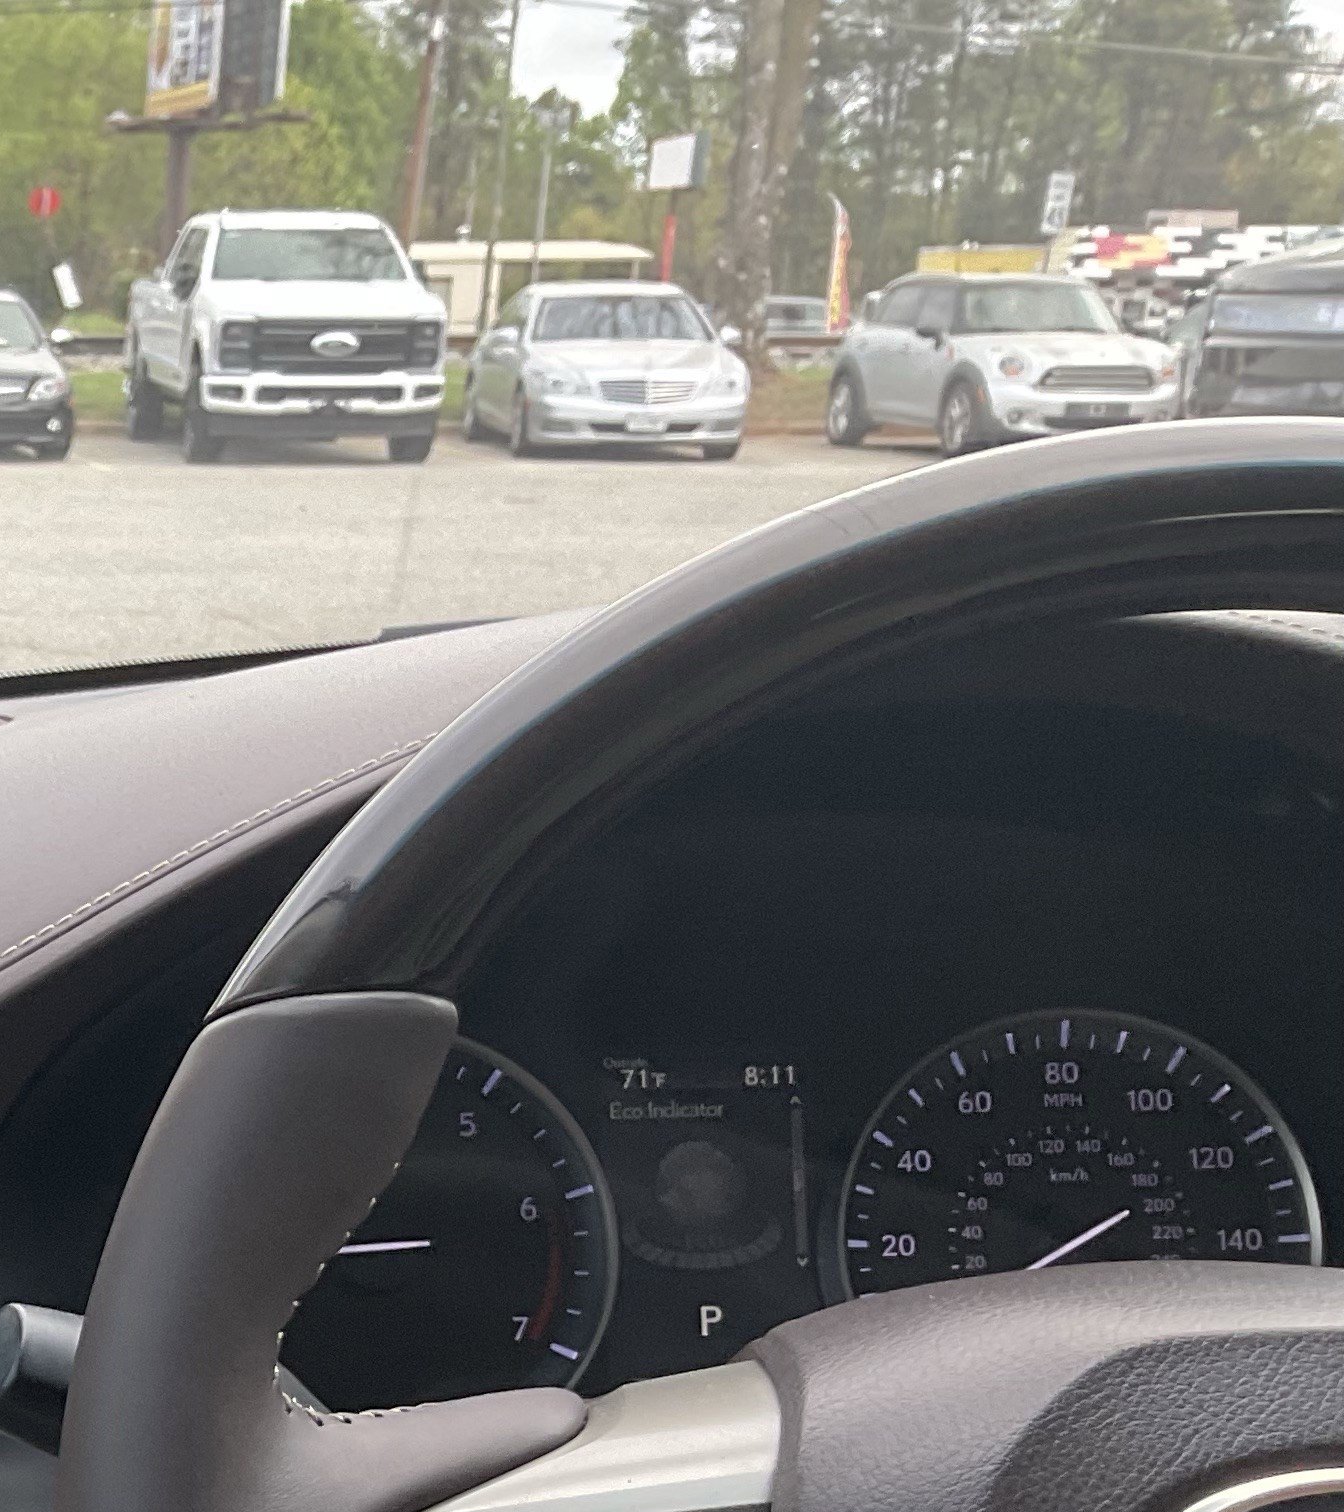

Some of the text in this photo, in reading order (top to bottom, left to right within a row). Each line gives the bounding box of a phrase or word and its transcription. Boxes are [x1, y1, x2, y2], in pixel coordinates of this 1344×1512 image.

[744, 1065, 795, 1087] 8:11
[1044, 1061, 1079, 1085] 80
[609, 1100, 724, 1119] Eco Indicator
[957, 1090, 993, 1114] 60
[1043, 1093, 1083, 1108] MPH
[1127, 1088, 1173, 1112] 100
[459, 1112, 477, 1137] 5
[1038, 1139, 1064, 1153] 120
[1076, 1138, 1101, 1153] 140
[897, 1149, 933, 1173] 40
[1006, 1153, 1033, 1167] 100
[1107, 1152, 1135, 1168] 160
[1189, 1146, 1234, 1170] 120
[983, 1171, 1004, 1186] 80
[1049, 1168, 1090, 1184] km/h
[519, 1196, 537, 1221] 6
[967, 1196, 988, 1211] 60
[1144, 1198, 1175, 1213] 200
[961, 1225, 983, 1240] 40
[1152, 1226, 1182, 1240] 220
[1216, 1228, 1263, 1251] 140
[881, 1233, 916, 1257] 20
[965, 1255, 986, 1270] 20
[512, 1316, 529, 1341] 7
[700, 1305, 722, 1336] P
